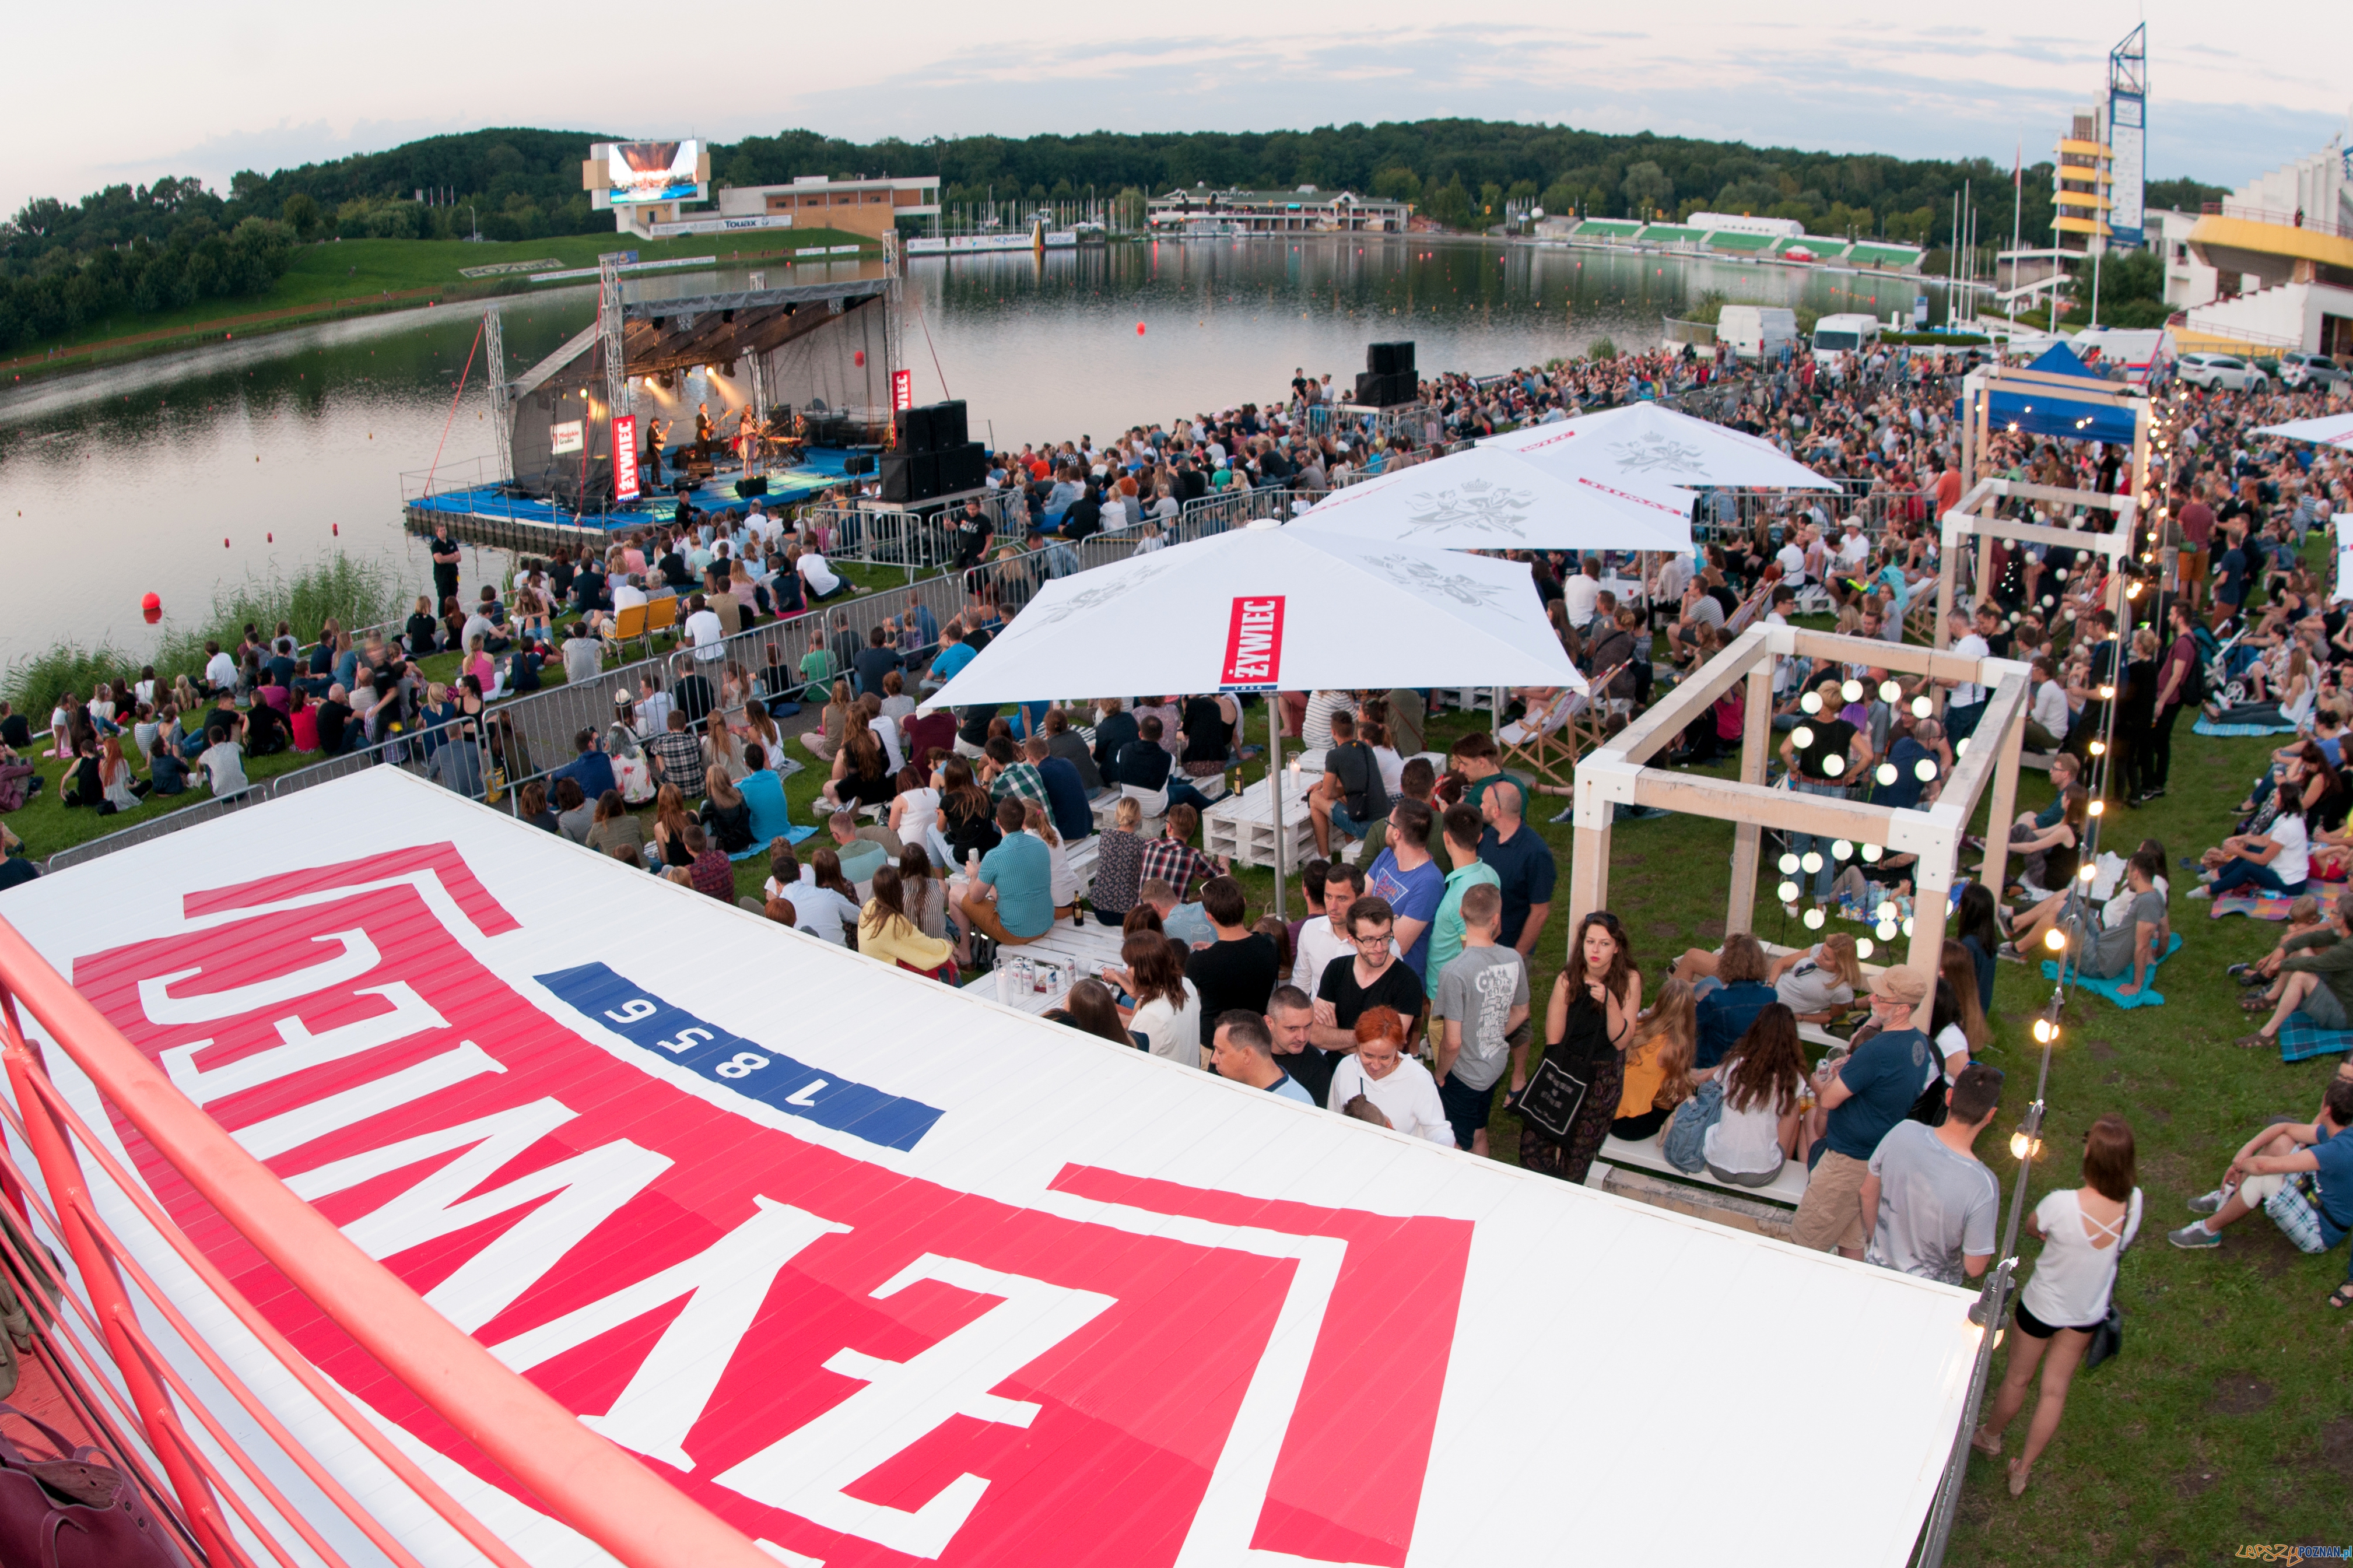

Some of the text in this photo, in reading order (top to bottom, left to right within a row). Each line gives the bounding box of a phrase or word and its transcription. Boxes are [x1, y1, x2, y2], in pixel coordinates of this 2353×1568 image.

[724, 219, 757, 229] Touax
[618, 421, 636, 492] ŻYWIEC
[1228, 600, 1276, 678] ŻYWIEC
[604, 999, 829, 1106] 1856
